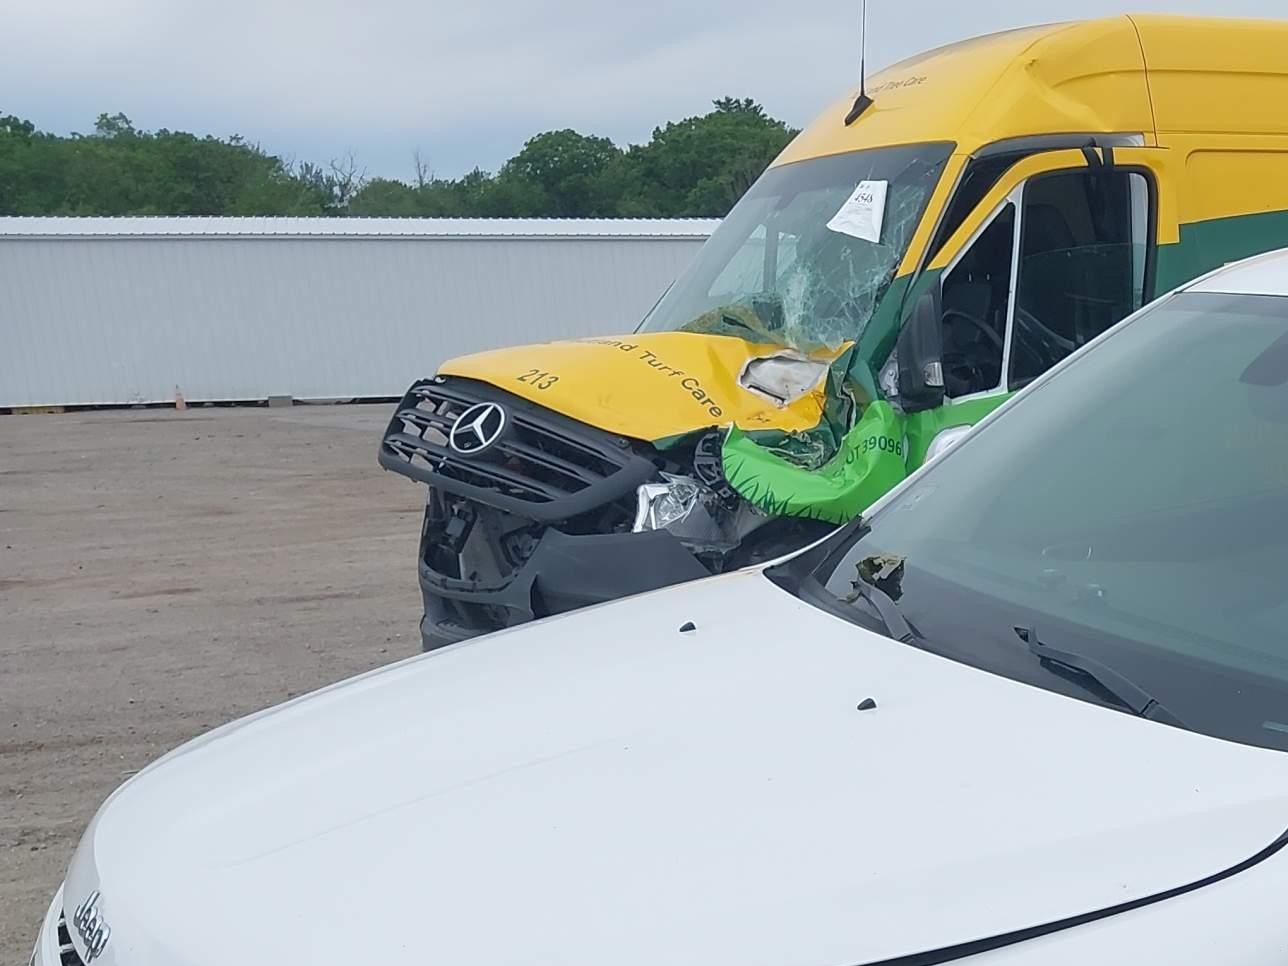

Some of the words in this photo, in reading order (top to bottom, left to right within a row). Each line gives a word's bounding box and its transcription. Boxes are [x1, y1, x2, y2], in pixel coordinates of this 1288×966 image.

[516, 368, 560, 390] 213
[639, 350, 684, 377] Turf
[681, 377, 723, 418] Care
[73, 890, 111, 963] Jeep
